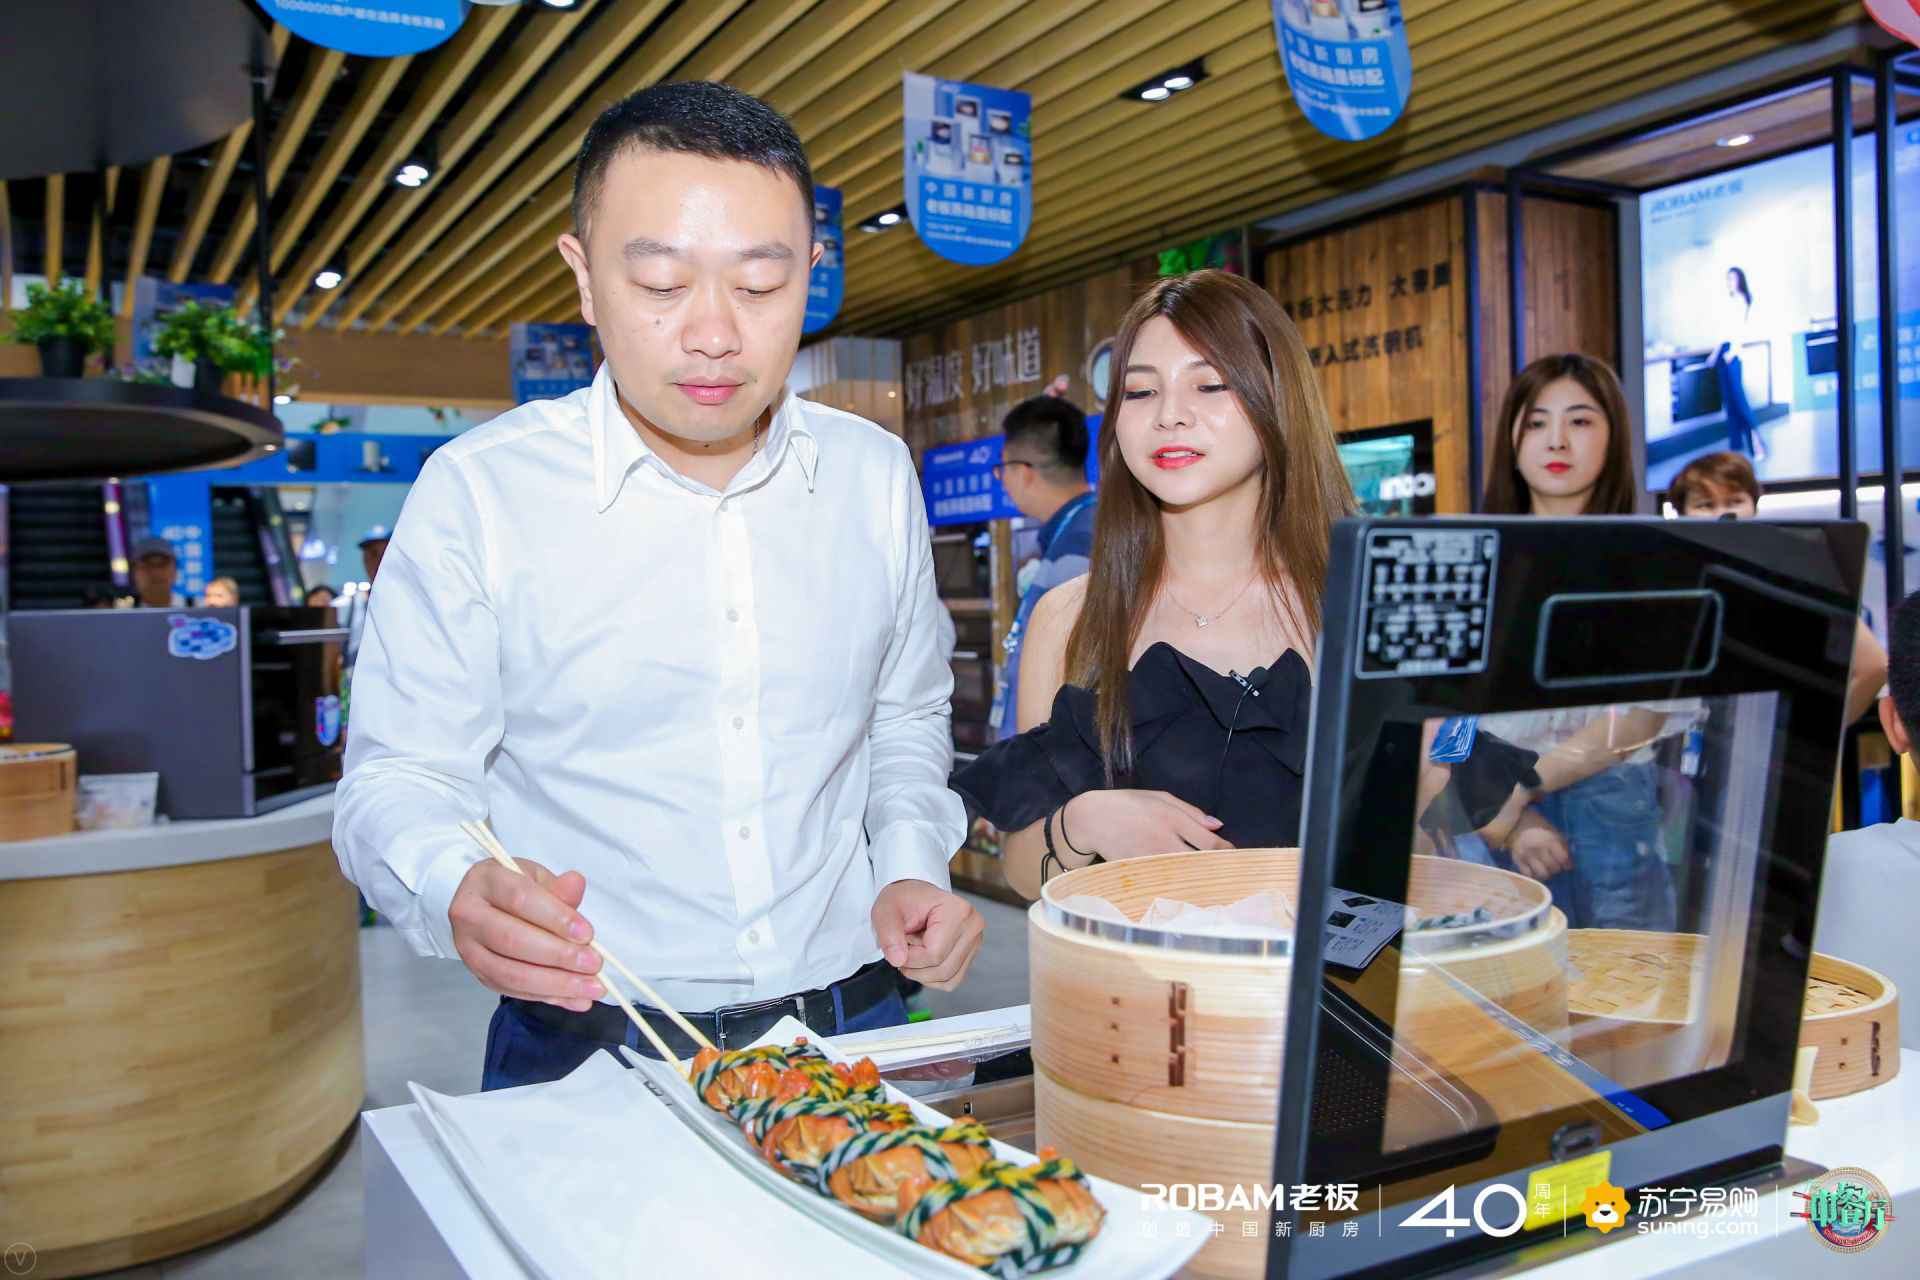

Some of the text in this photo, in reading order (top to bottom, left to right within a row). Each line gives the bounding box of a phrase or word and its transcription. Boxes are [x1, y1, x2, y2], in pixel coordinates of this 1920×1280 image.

[905, 327, 1041, 410] 好温度 好味道
